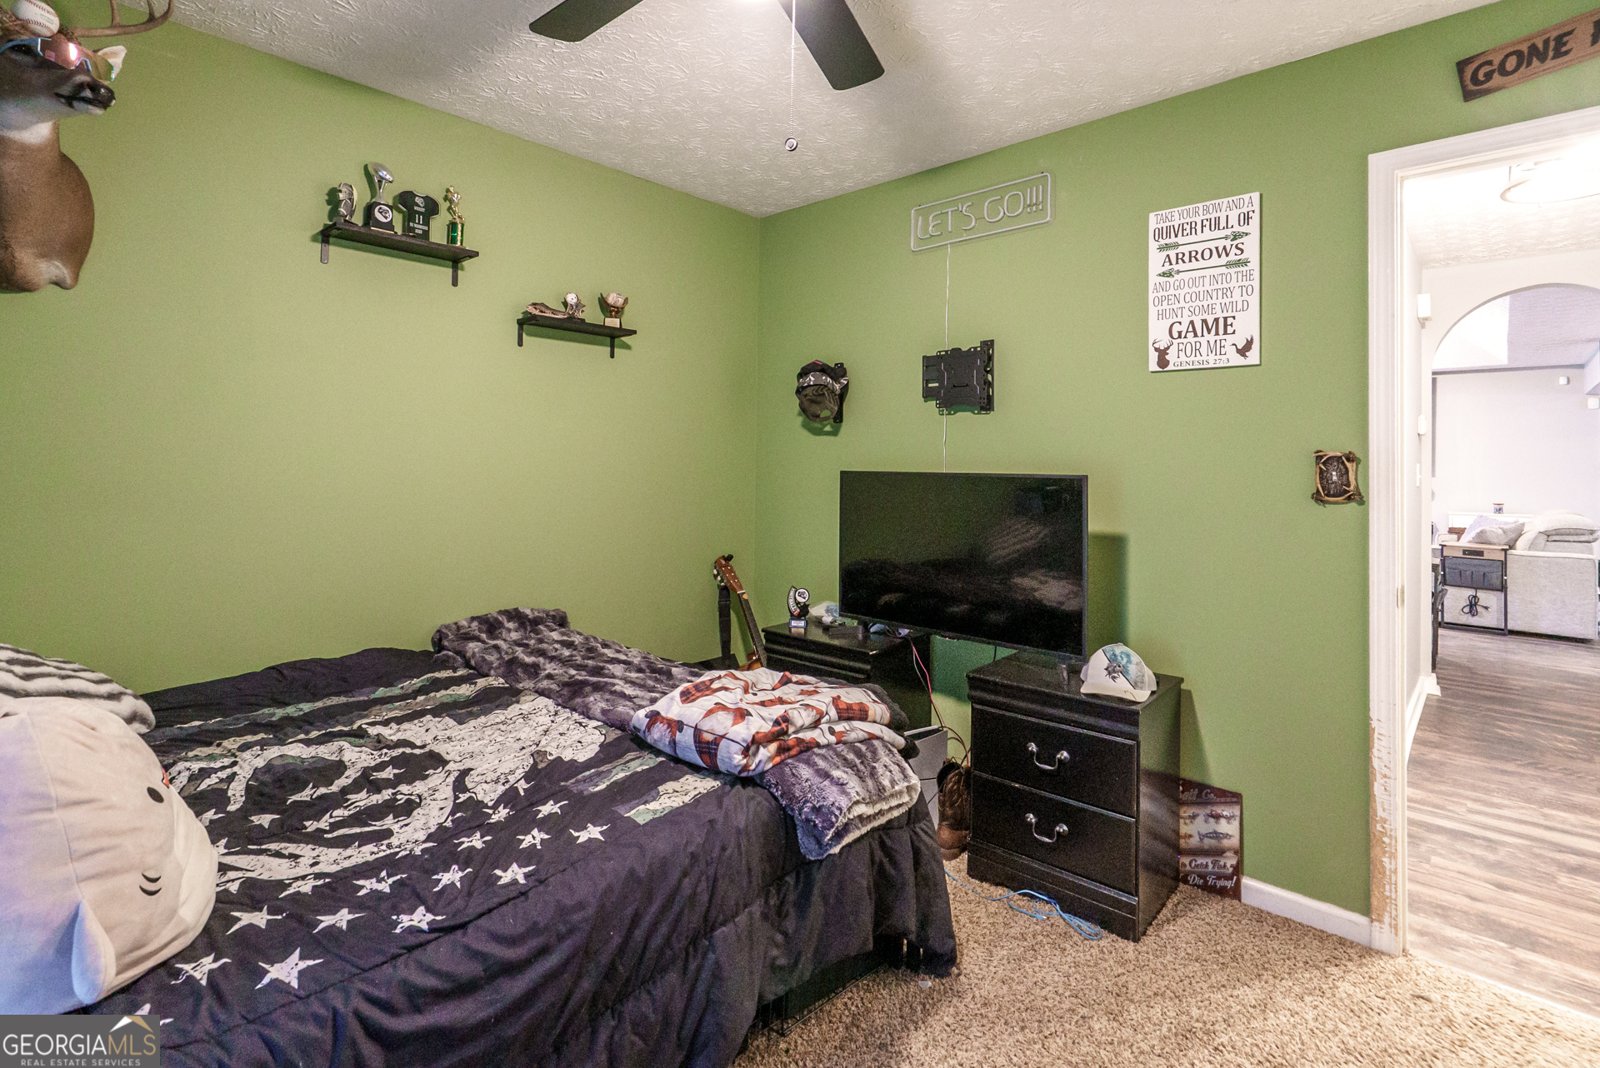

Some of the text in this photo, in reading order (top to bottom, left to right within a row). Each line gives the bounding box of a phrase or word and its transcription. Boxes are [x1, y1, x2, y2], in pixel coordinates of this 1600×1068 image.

[1470, 27, 1577, 87] GONE
[917, 185, 1043, 239] LET'S GO!!!
[1154, 195, 1254, 225] TAKE YOUR BOW AND A
[1153, 209, 1255, 242] QUIVER FULL OF
[1161, 242, 1245, 267] ARROWS
[1152, 269, 1255, 294] AND GO OUT INTO THE
[1152, 284, 1254, 308] OPEN COUNTRY TO
[1156, 299, 1250, 320] HUNT SOME WILD
[1168, 315, 1236, 340] GAME
[1176, 338, 1227, 359] FOR ME
[1173, 359, 1210, 368] GENESIS
[1179, 785, 1199, 800] ait
[1188, 874, 1237, 889] Die Trying!
